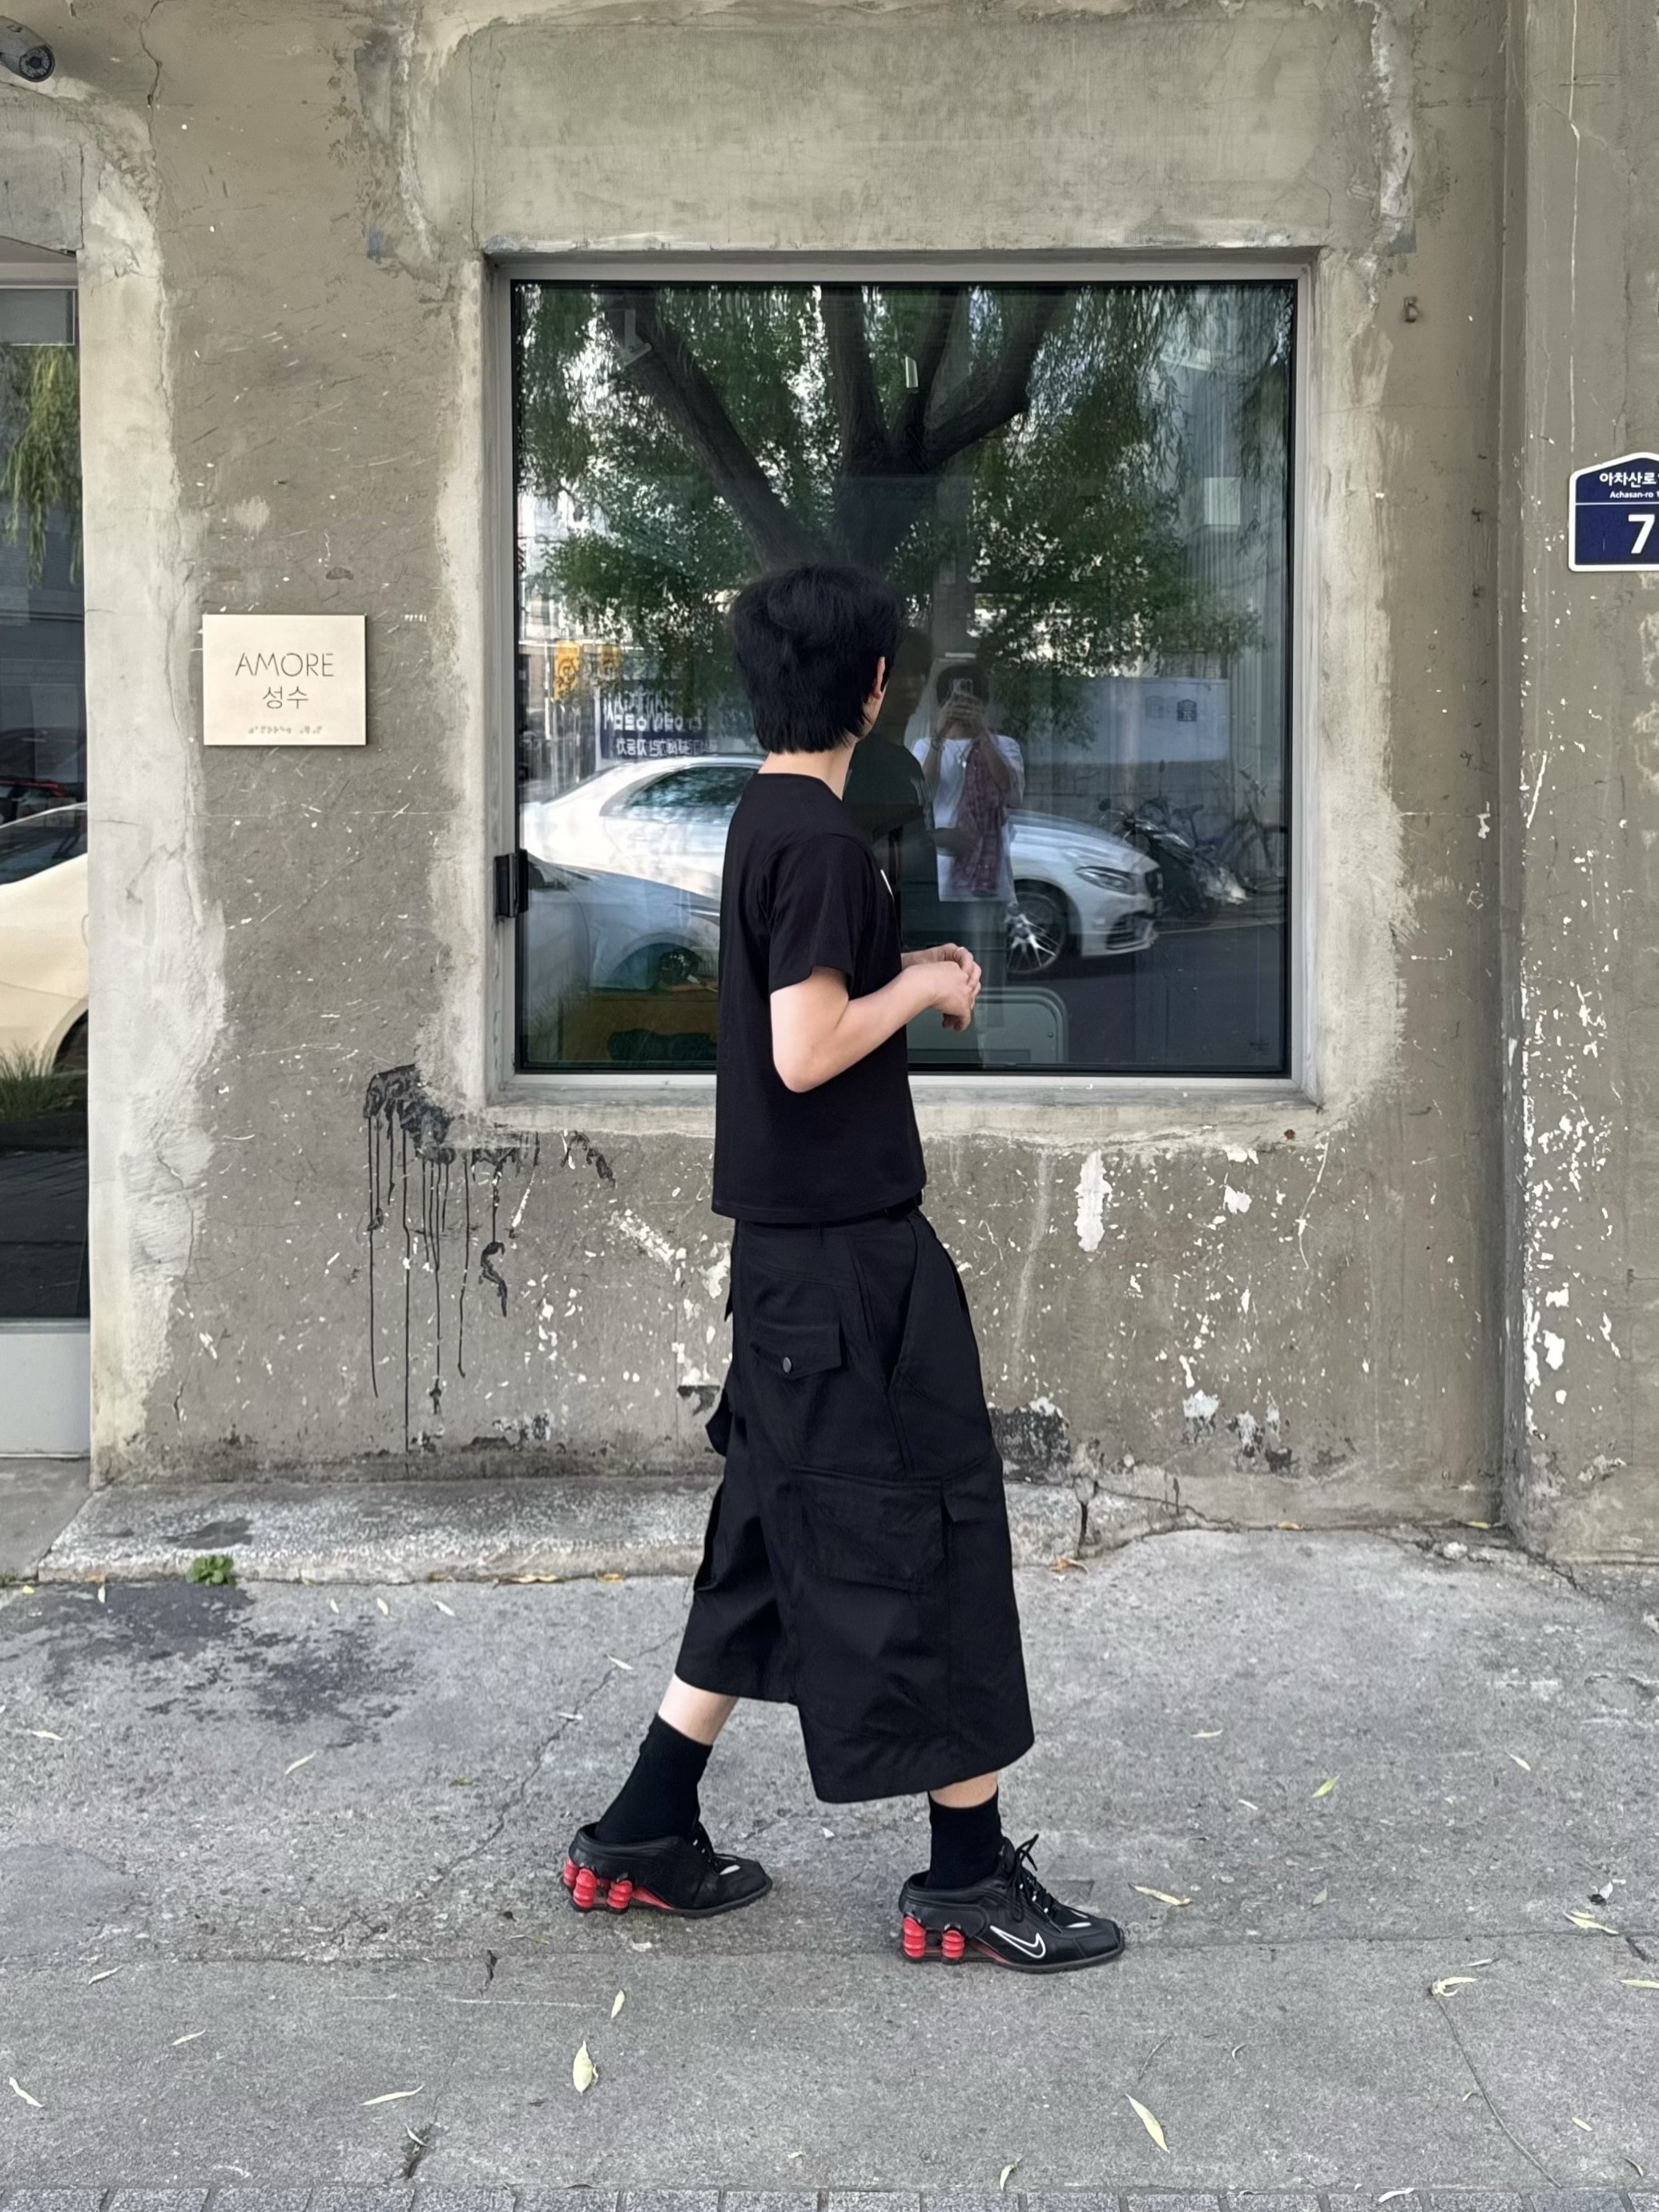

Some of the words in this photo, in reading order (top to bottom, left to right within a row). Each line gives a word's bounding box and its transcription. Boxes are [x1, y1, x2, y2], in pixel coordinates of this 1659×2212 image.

[1599, 471, 1657, 488] 아차산로
[1609, 490, 1654, 498] Achasan-ro
[1628, 514, 1655, 554] 7
[235, 652, 334, 677] AMORE
[262, 686, 309, 710] 성수
